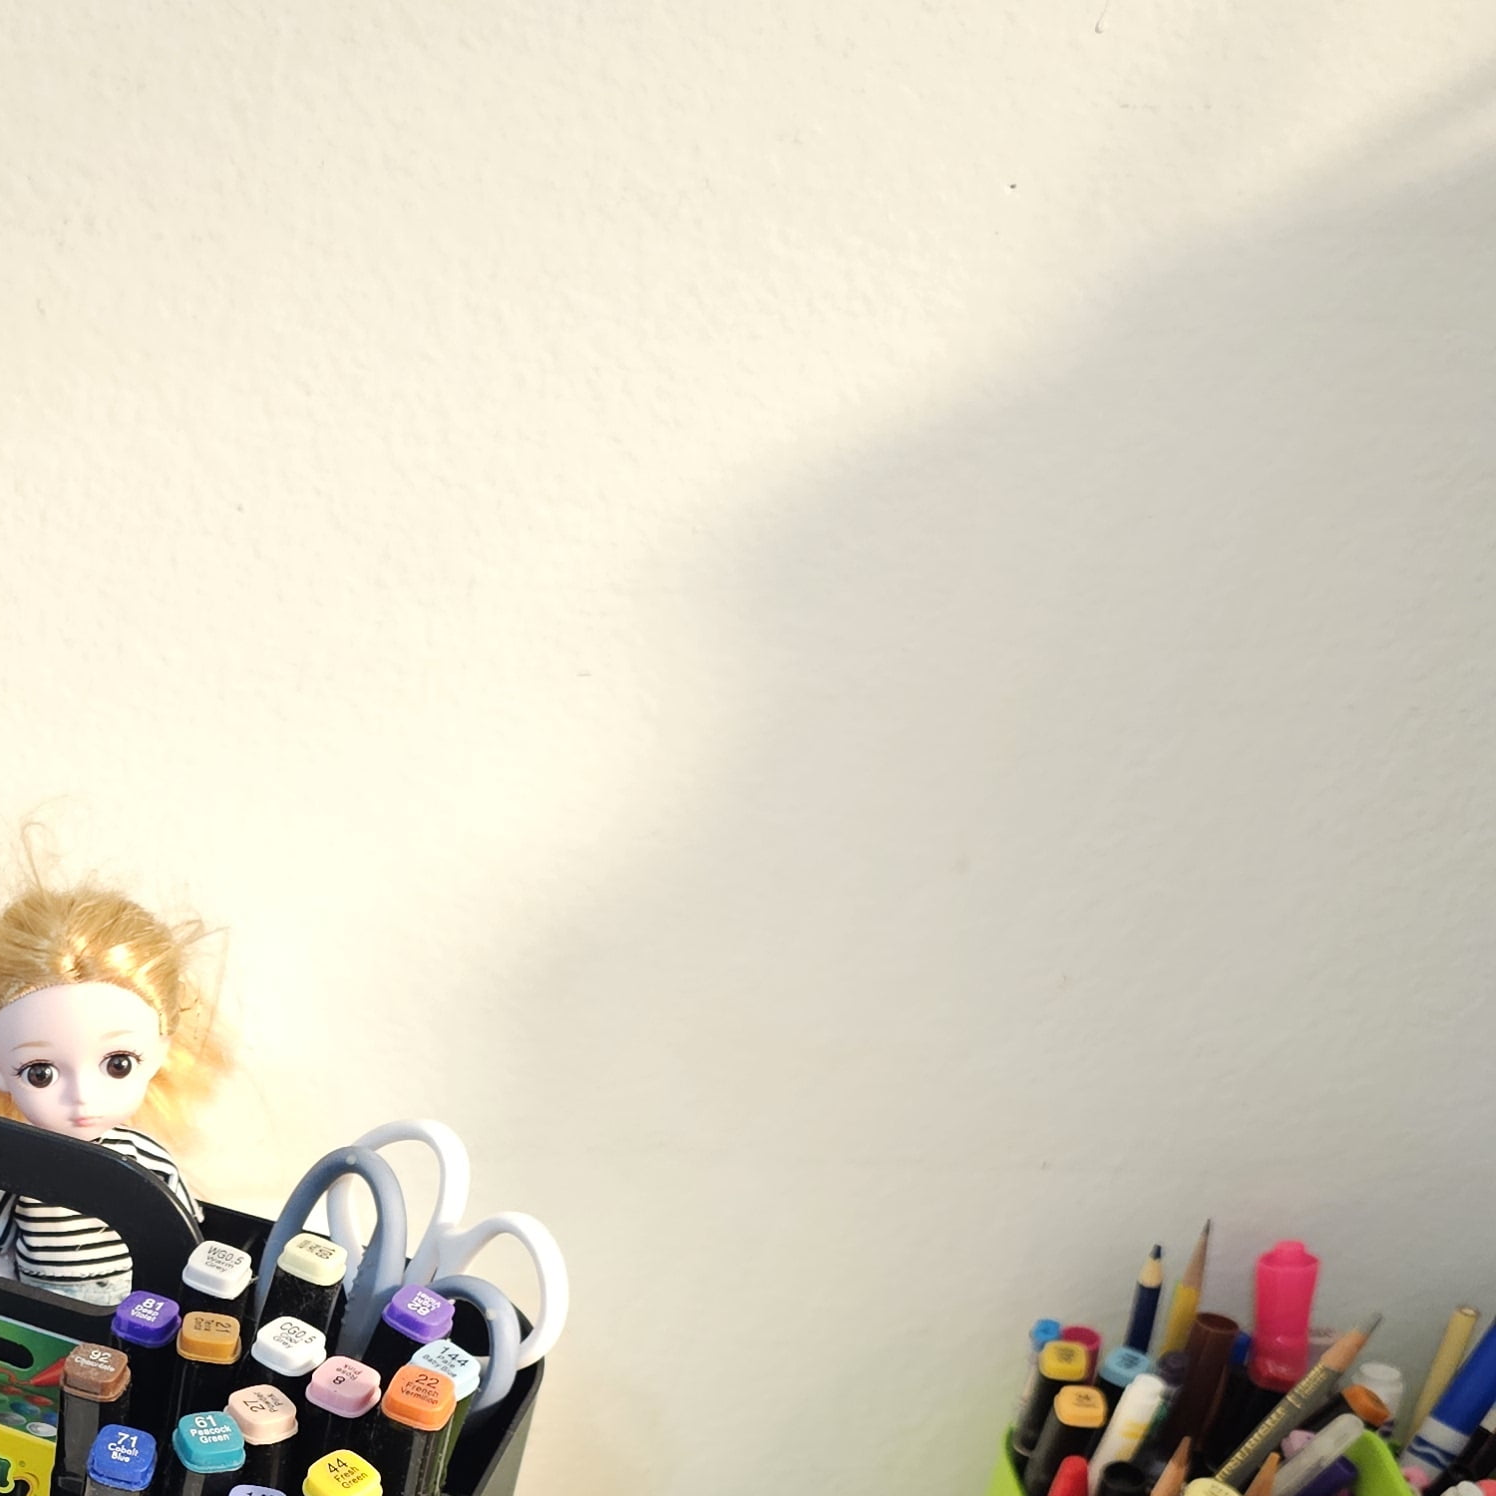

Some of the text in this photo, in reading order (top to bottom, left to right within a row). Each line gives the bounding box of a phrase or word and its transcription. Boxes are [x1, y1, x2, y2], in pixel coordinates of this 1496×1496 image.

[206, 1256, 234, 1269] Warm
[208, 1246, 244, 1266] WG0.5
[205, 1261, 227, 1273] Grey
[134, 1304, 160, 1317] Deep
[142, 1298, 165, 1310] 81
[407, 1302, 431, 1315] 82
[130, 1309, 157, 1323] Violet
[215, 1320, 232, 1334] 21
[280, 1322, 316, 1344] CG0.5
[89, 1350, 112, 1363] 92
[437, 1354, 457, 1369] Pale
[442, 1346, 470, 1368] 144
[332, 1376, 345, 1385] 8
[335, 1367, 358, 1381] Rose
[415, 1374, 439, 1389] 22
[405, 1381, 440, 1398] French
[243, 1398, 266, 1414] 27
[194, 1415, 217, 1428] 61
[189, 1426, 232, 1438] Peacock
[199, 1433, 230, 1444] Green
[117, 1432, 139, 1448] 71
[108, 1443, 139, 1458] Cobalt
[110, 1452, 131, 1463] Blue
[327, 1458, 349, 1474] 44
[333, 1465, 360, 1484] Fresh
[341, 1472, 369, 1490] Green
